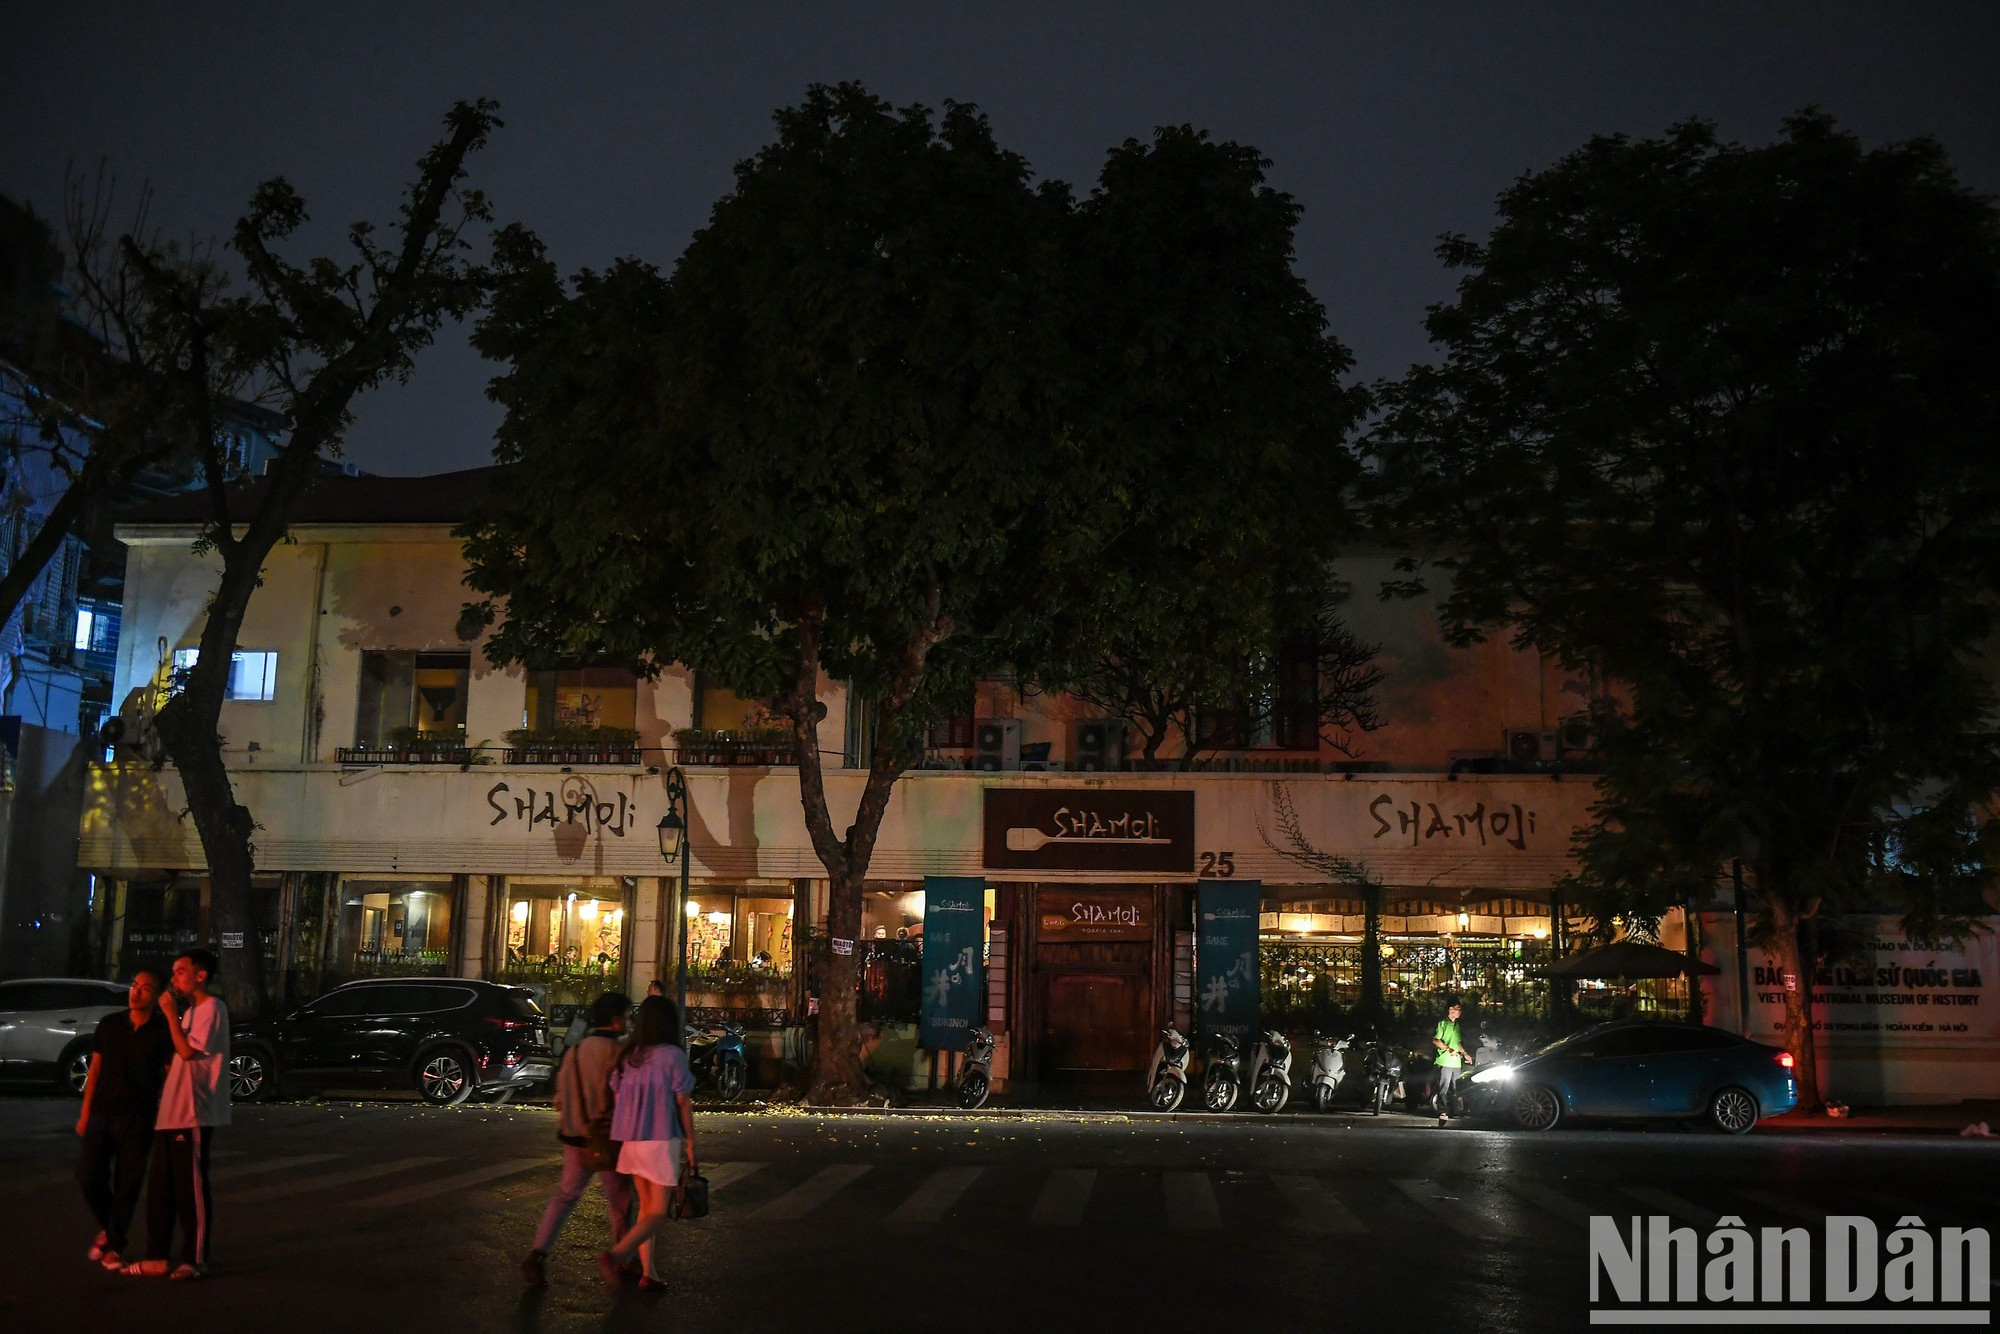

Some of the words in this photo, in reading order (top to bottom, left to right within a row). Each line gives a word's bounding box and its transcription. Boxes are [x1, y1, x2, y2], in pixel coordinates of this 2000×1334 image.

[1200, 851, 1235, 877] 25
[1877, 962, 1901, 987] SỬ
[1903, 960, 1949, 989] QUỐC
[1865, 993, 1914, 1005] MUSEUM
[1916, 994, 1930, 1005] OF
[1932, 994, 1979, 1005] HISTORY
